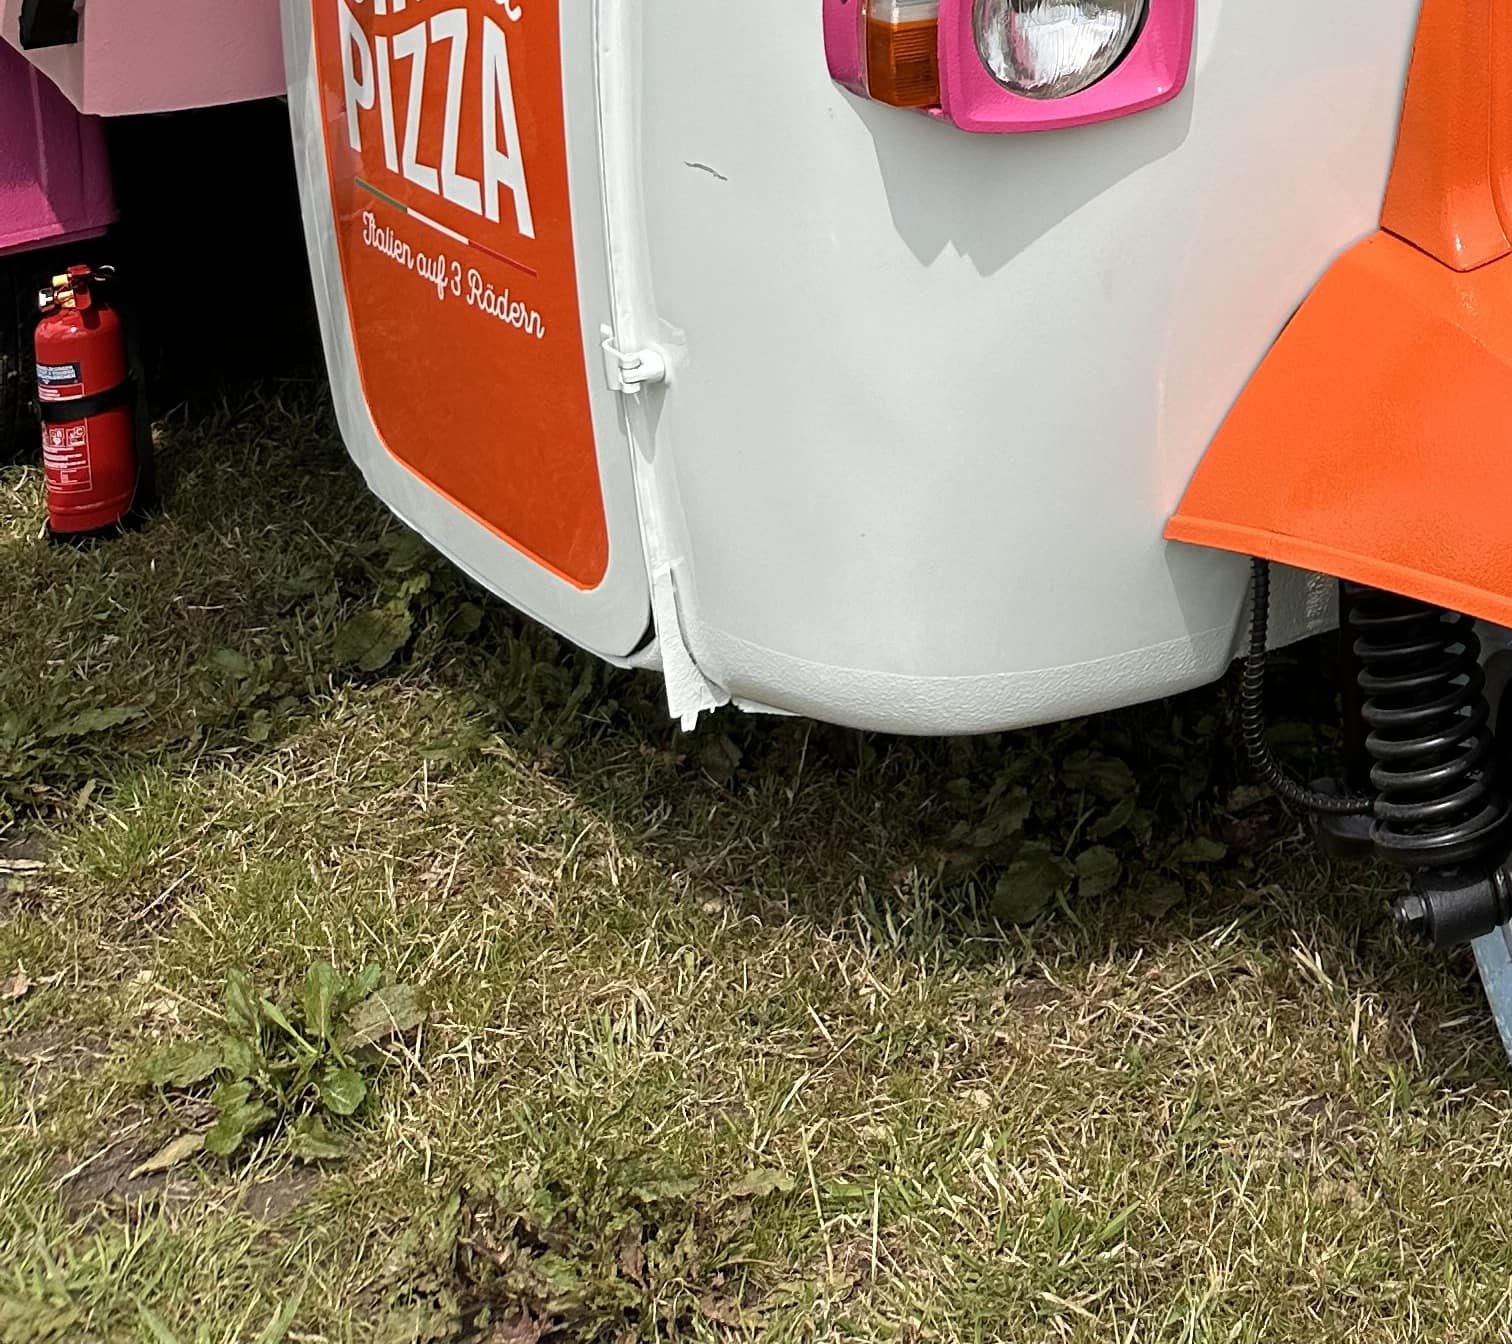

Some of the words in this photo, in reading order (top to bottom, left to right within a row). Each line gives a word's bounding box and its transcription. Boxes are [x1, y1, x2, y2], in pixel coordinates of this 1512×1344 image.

[362, 211, 414, 269] Italien
[416, 253, 449, 301] auf
[450, 261, 463, 297] 3
[466, 268, 545, 339] Rädern
